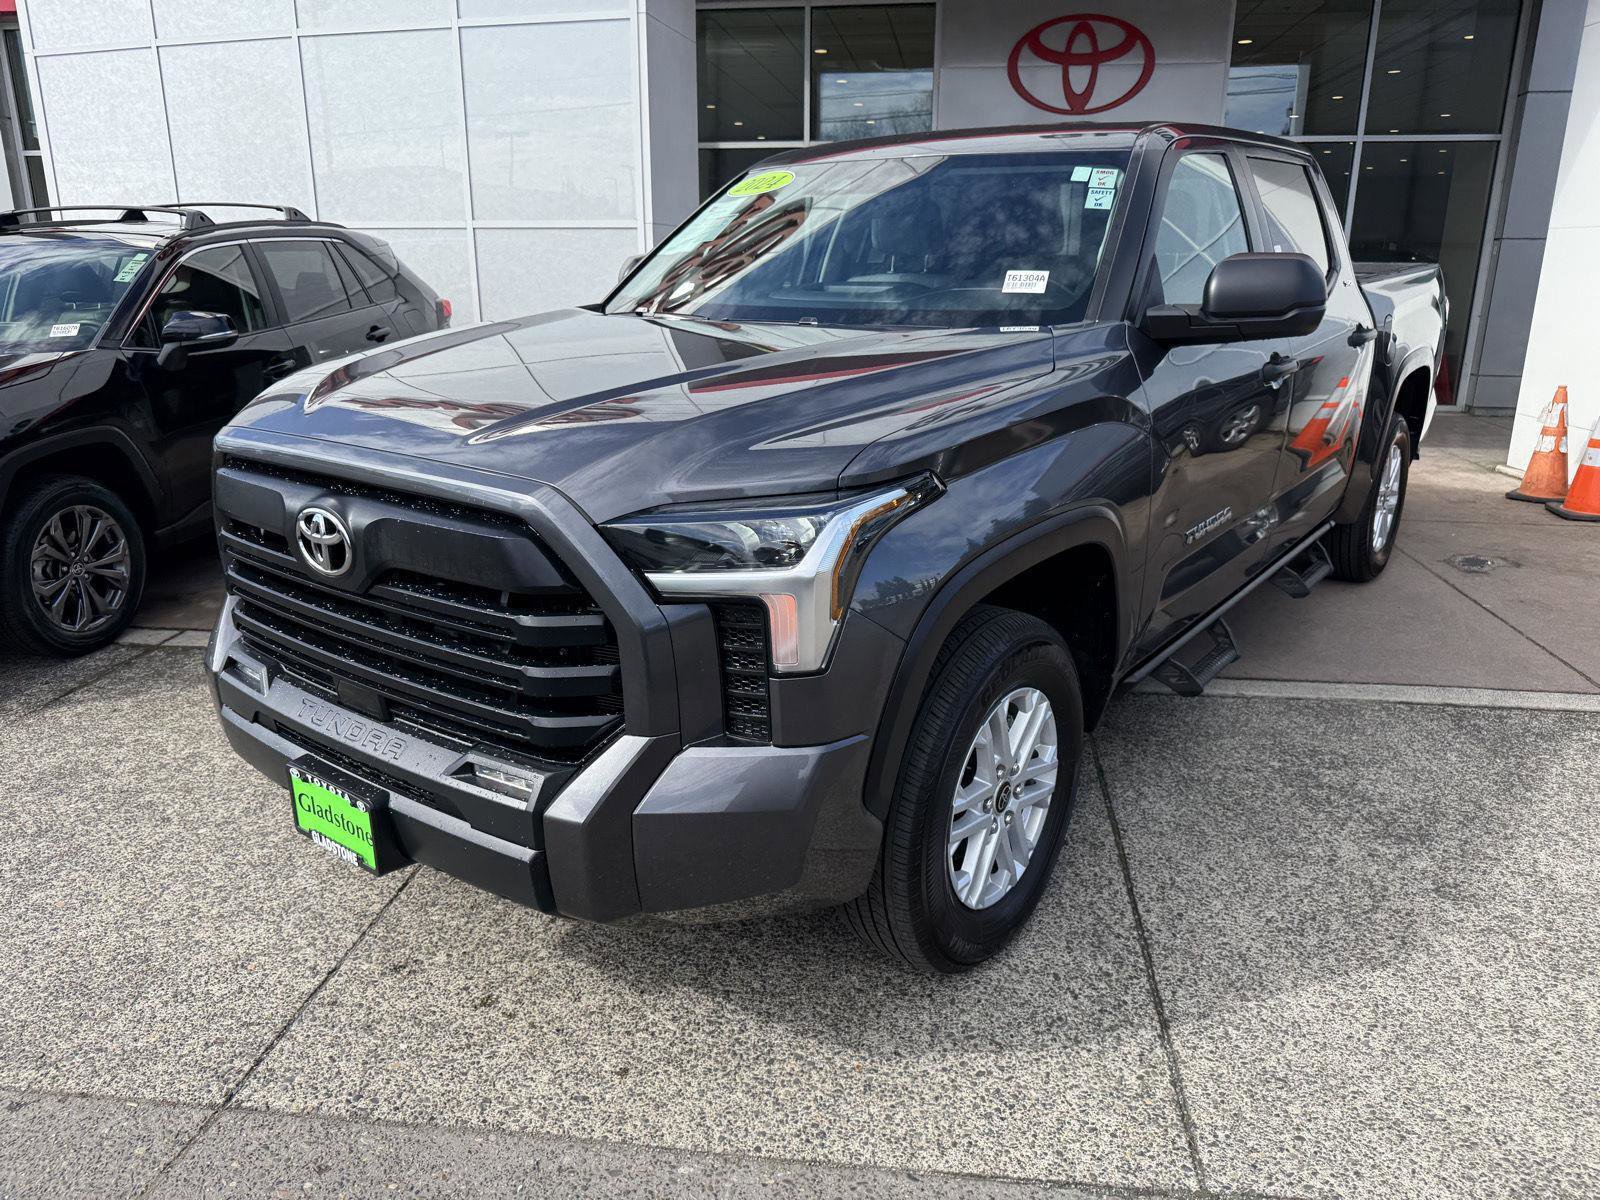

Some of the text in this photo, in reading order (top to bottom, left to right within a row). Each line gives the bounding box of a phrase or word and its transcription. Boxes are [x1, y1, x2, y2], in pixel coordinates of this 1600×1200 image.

[1007, 274, 1046, 283] T61304A
[1184, 506, 1233, 545] TUNDRA
[298, 698, 408, 761] TUNDRA
[306, 773, 351, 805] TOYOTA
[298, 792, 374, 847] Gladstone
[311, 830, 359, 867] GLADSTONE
